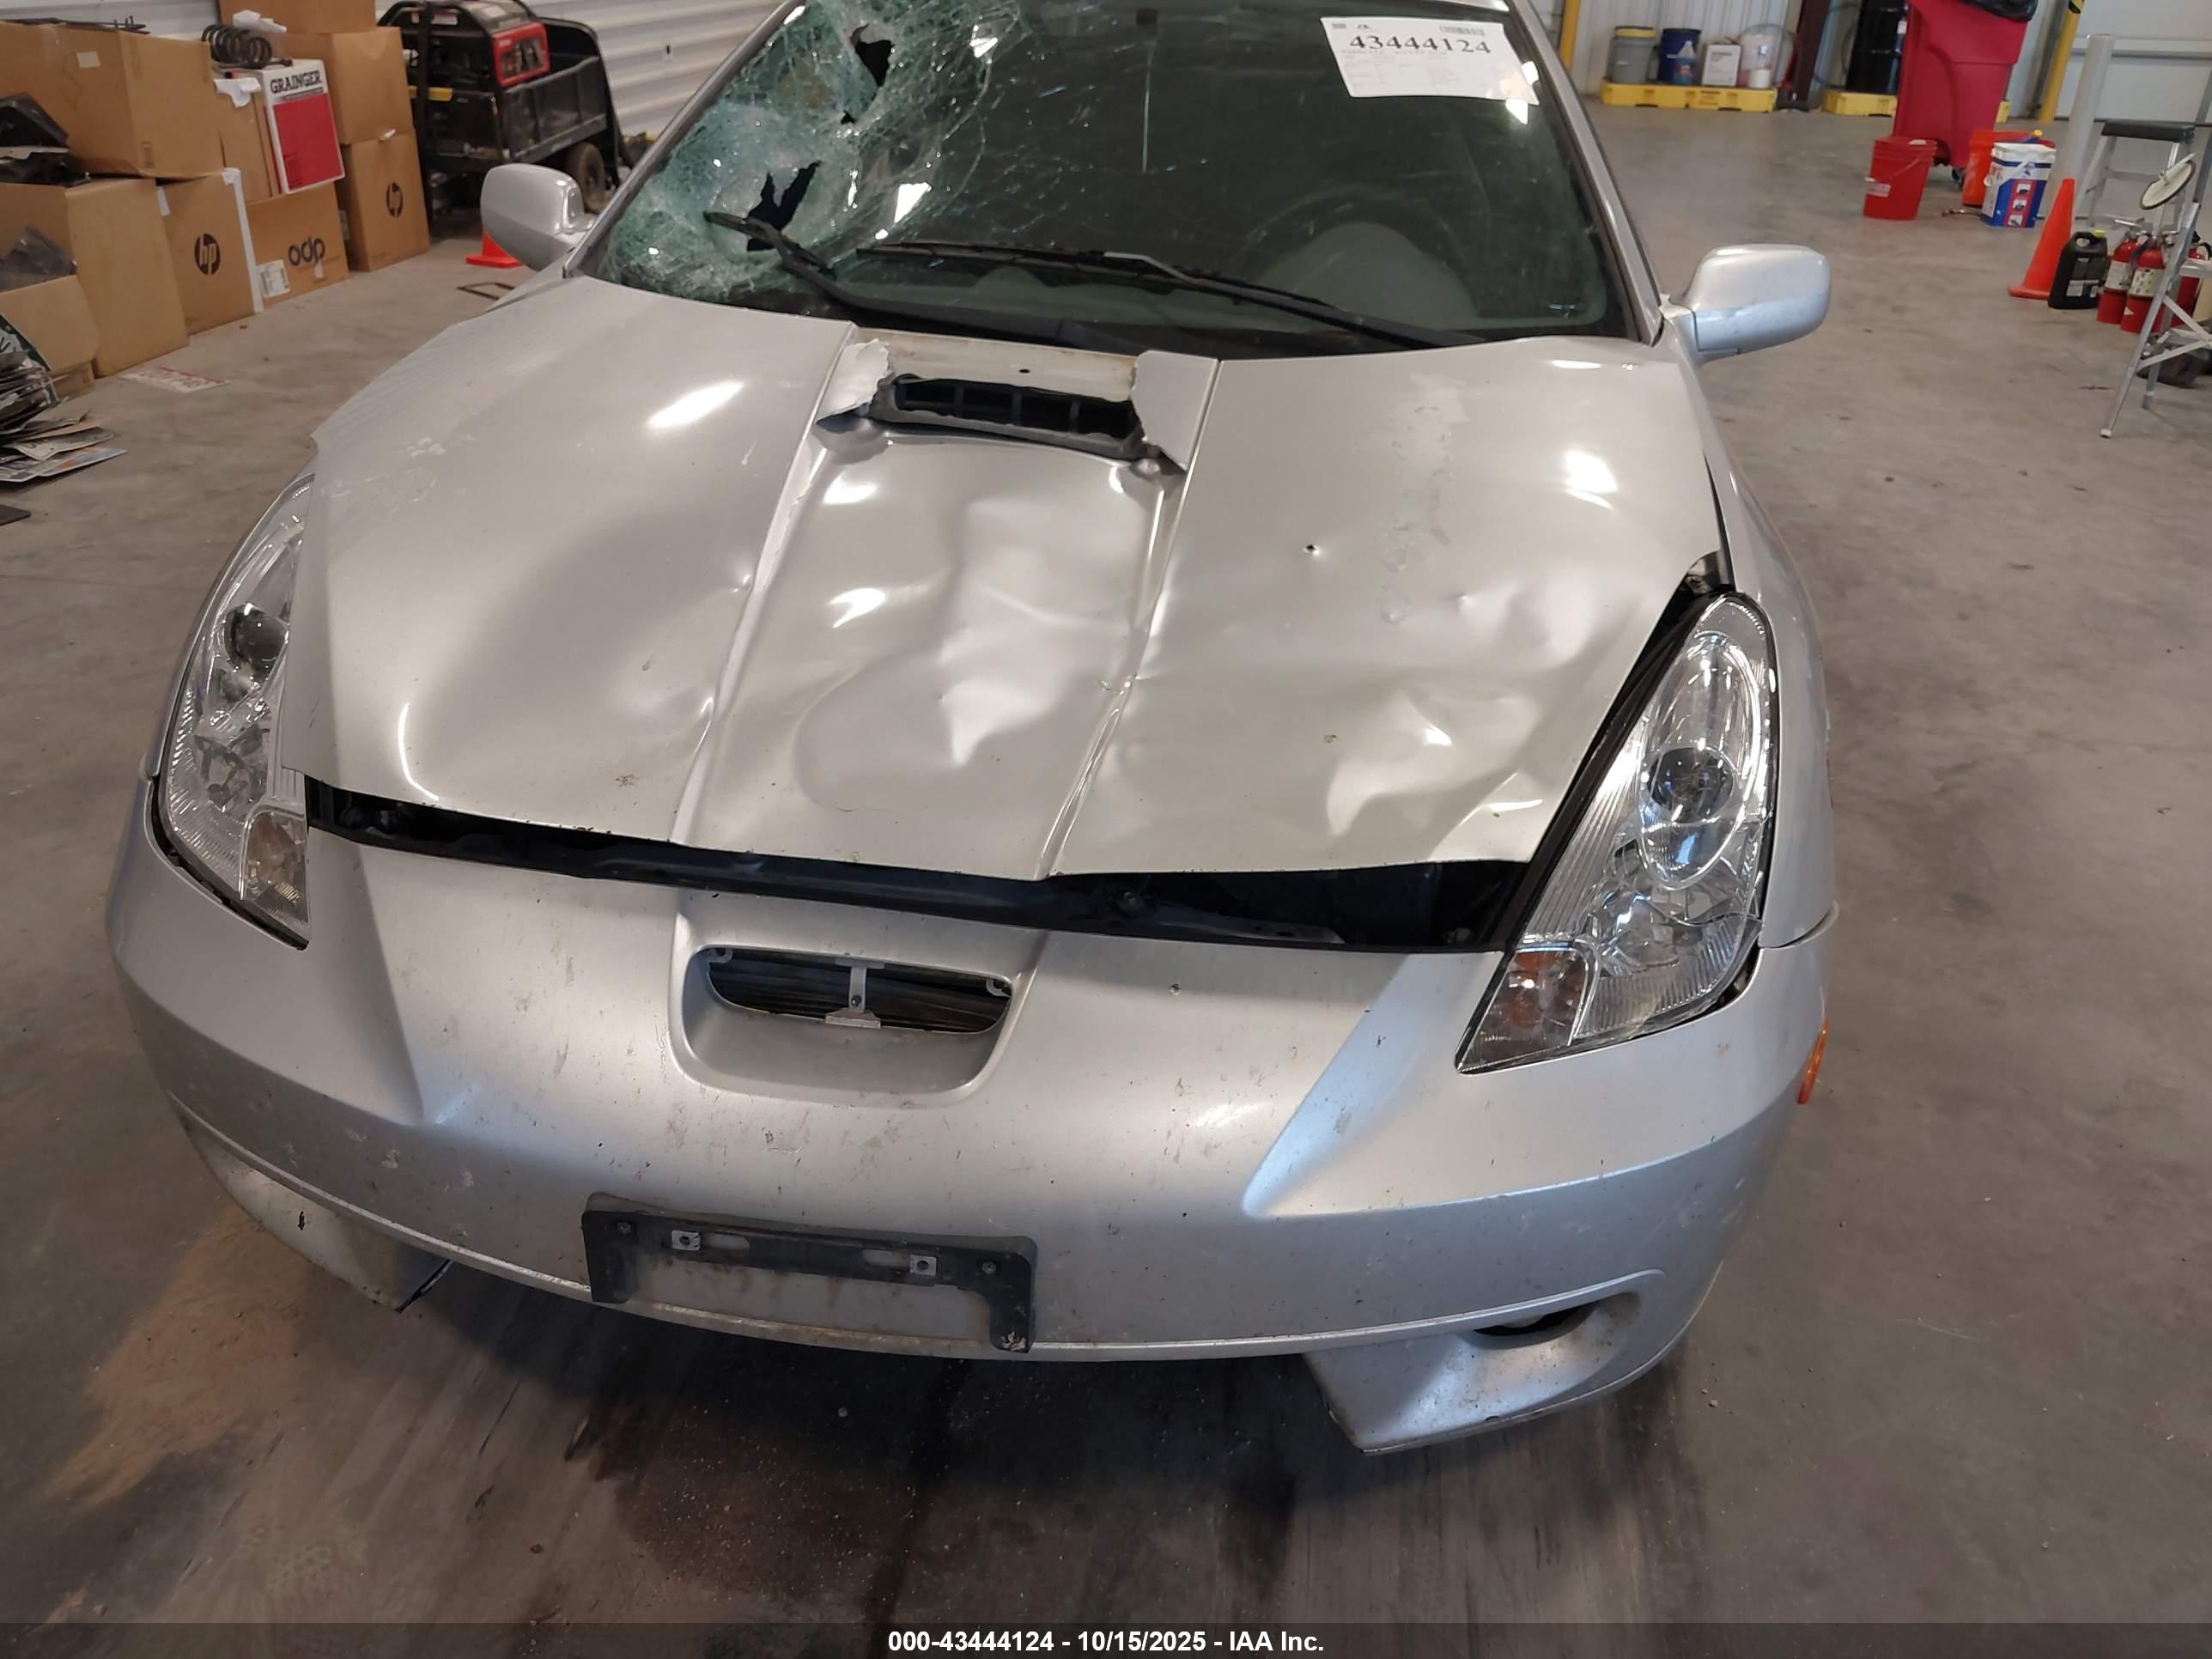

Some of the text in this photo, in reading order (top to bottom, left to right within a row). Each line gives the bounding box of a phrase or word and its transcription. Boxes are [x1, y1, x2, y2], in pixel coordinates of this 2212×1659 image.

[1350, 35, 1491, 53] 43444124
[270, 70, 322, 94] GRAINGER
[196, 234, 220, 275] hp
[289, 235, 325, 266] odp
